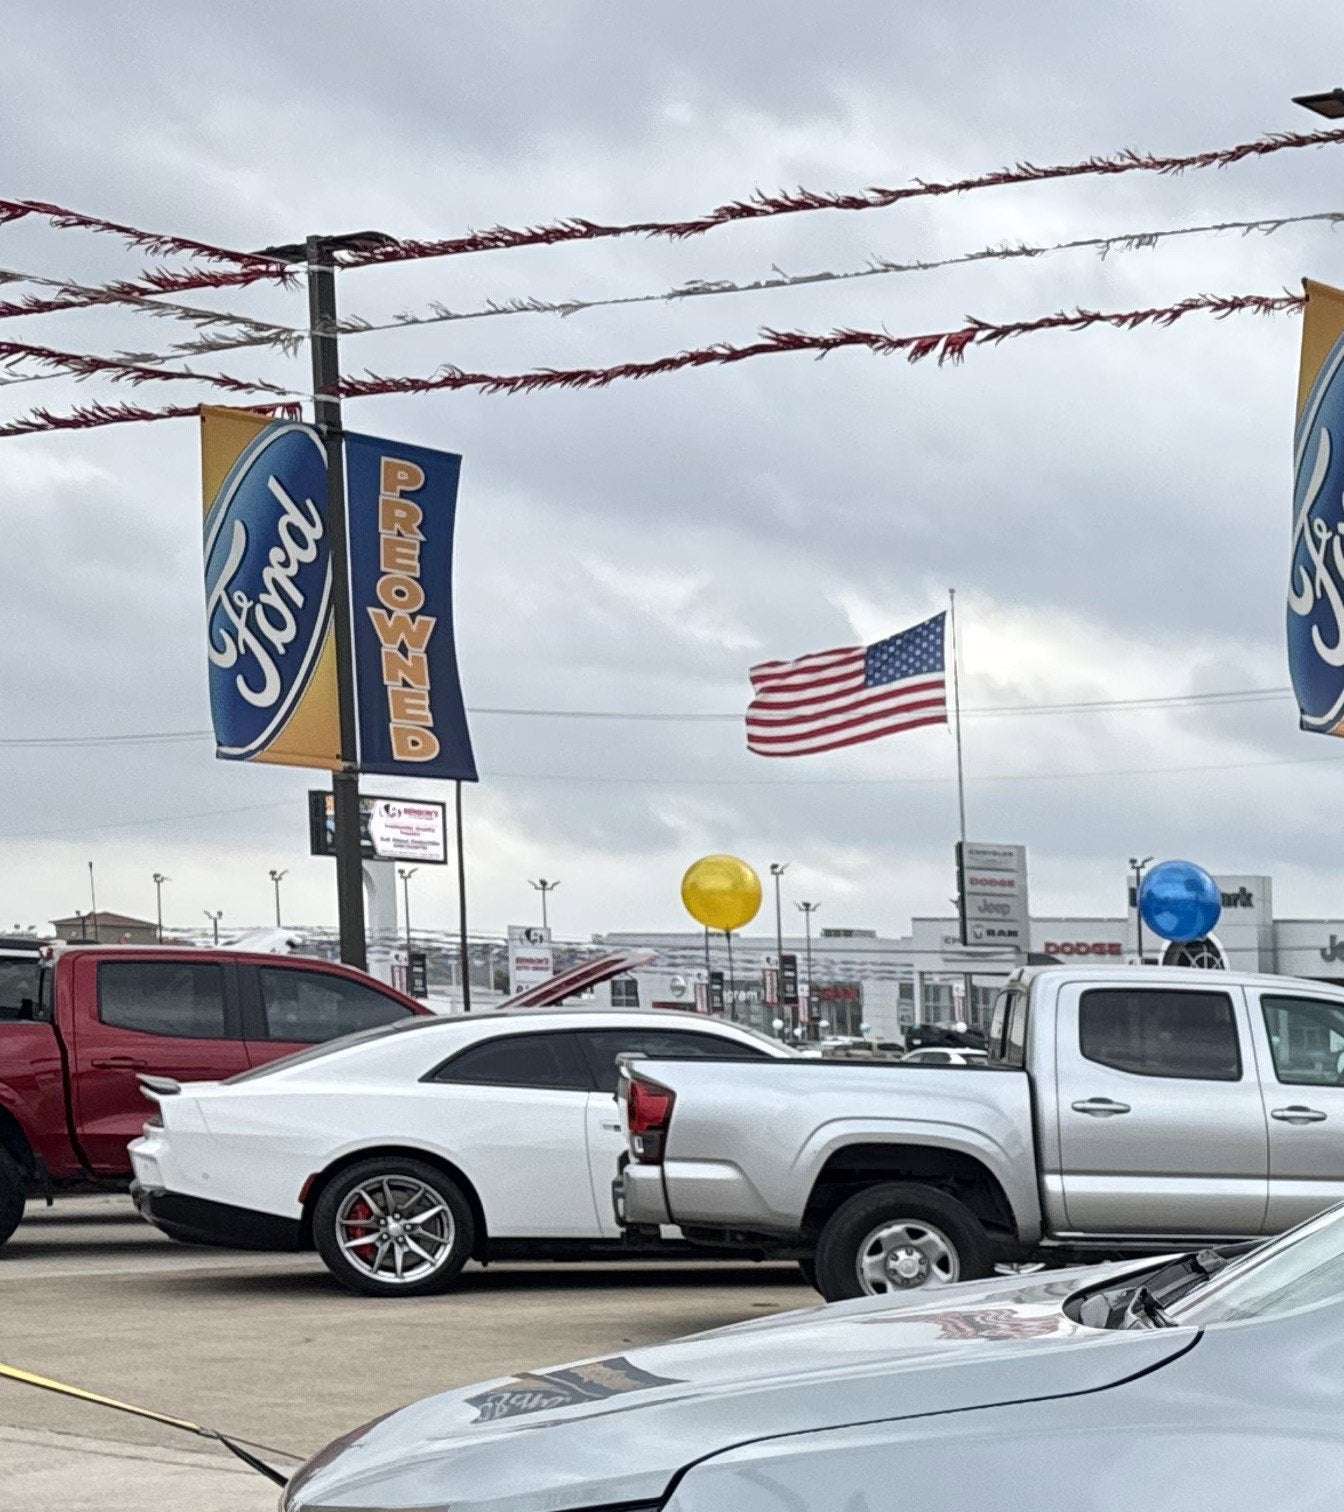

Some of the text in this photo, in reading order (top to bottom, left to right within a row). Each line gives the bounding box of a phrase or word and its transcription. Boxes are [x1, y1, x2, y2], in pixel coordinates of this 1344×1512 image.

[208, 475, 324, 708] Ford
[366, 456, 441, 762] PREOWNED
[969, 877, 1016, 888] DODGE
[977, 901, 1011, 916] Jeep
[985, 928, 1019, 938] RAM
[1044, 941, 1122, 955] DODGE
